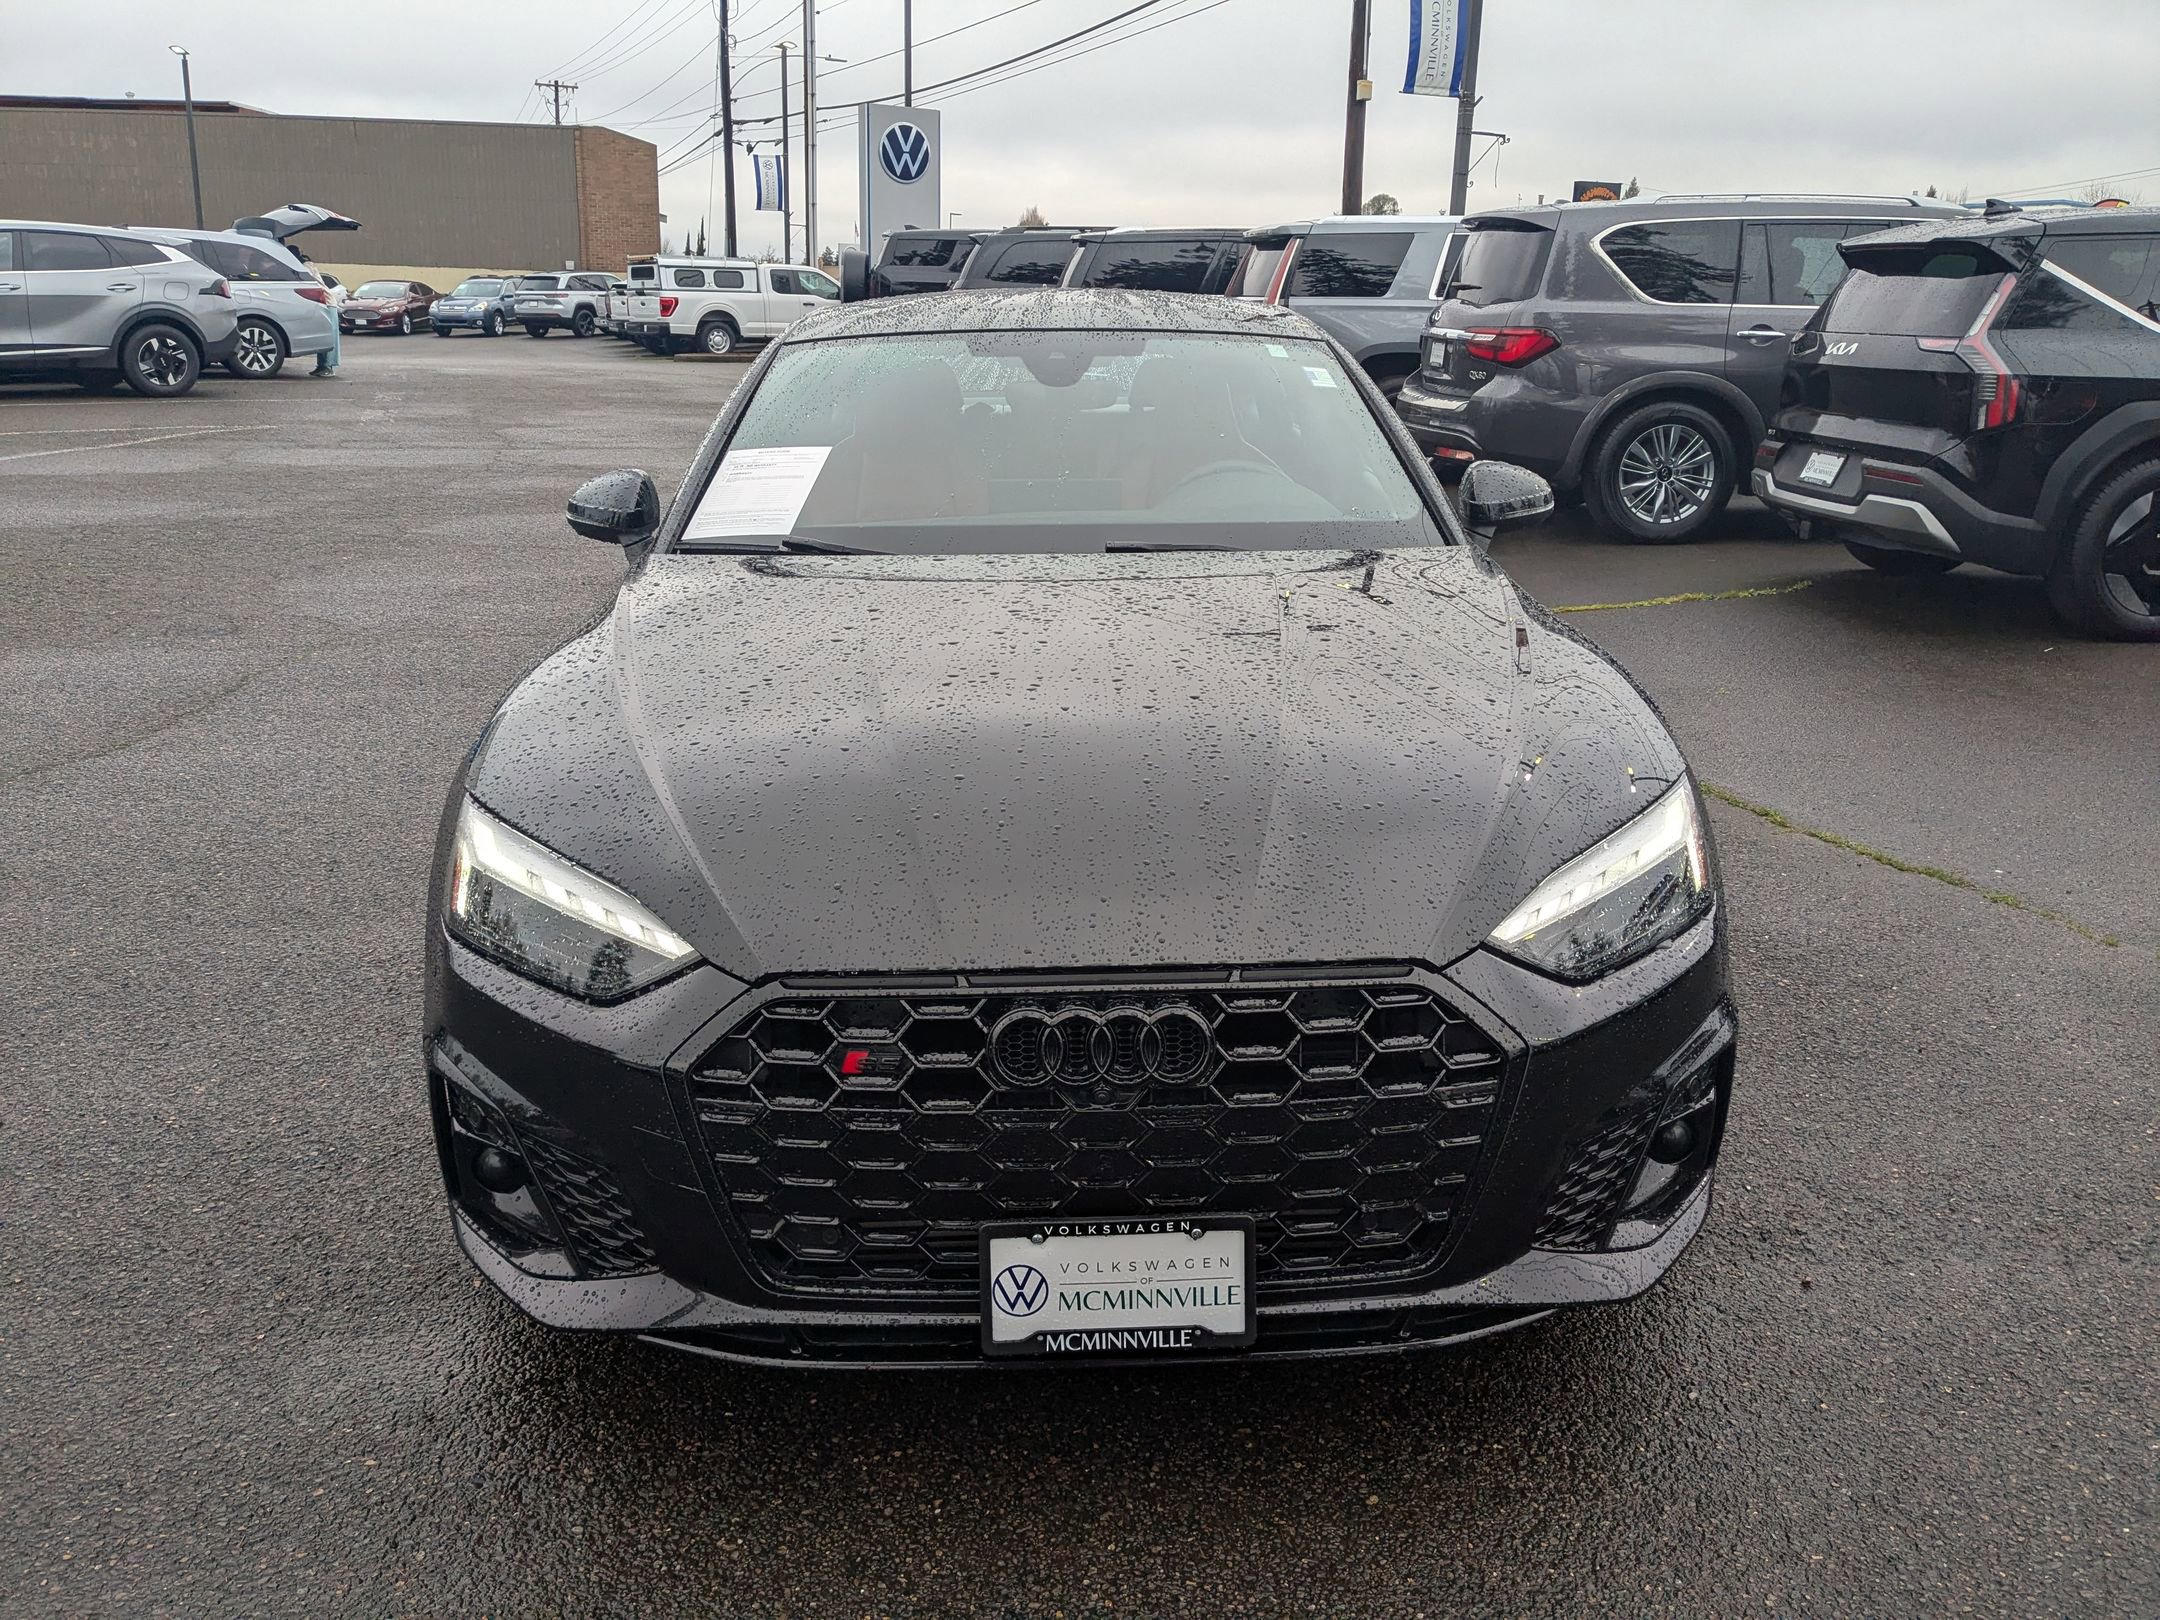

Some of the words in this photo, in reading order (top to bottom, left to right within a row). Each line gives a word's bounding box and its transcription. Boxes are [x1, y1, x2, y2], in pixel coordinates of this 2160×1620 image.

[1424, 1, 1441, 81] CMINNVILLE
[1440, 0, 1452, 77] OLKSWAGEN
[881, 123, 930, 180] VW
[1043, 1221, 1191, 1236] VOLKSWAGEN
[1060, 1257, 1231, 1274] VOLKSWAGEN
[993, 1265, 1048, 1315] VW
[1140, 1276, 1154, 1285] OF
[1059, 1285, 1241, 1312] MCMINNVILLE
[1046, 1329, 1193, 1352] MCMINNVILLE
